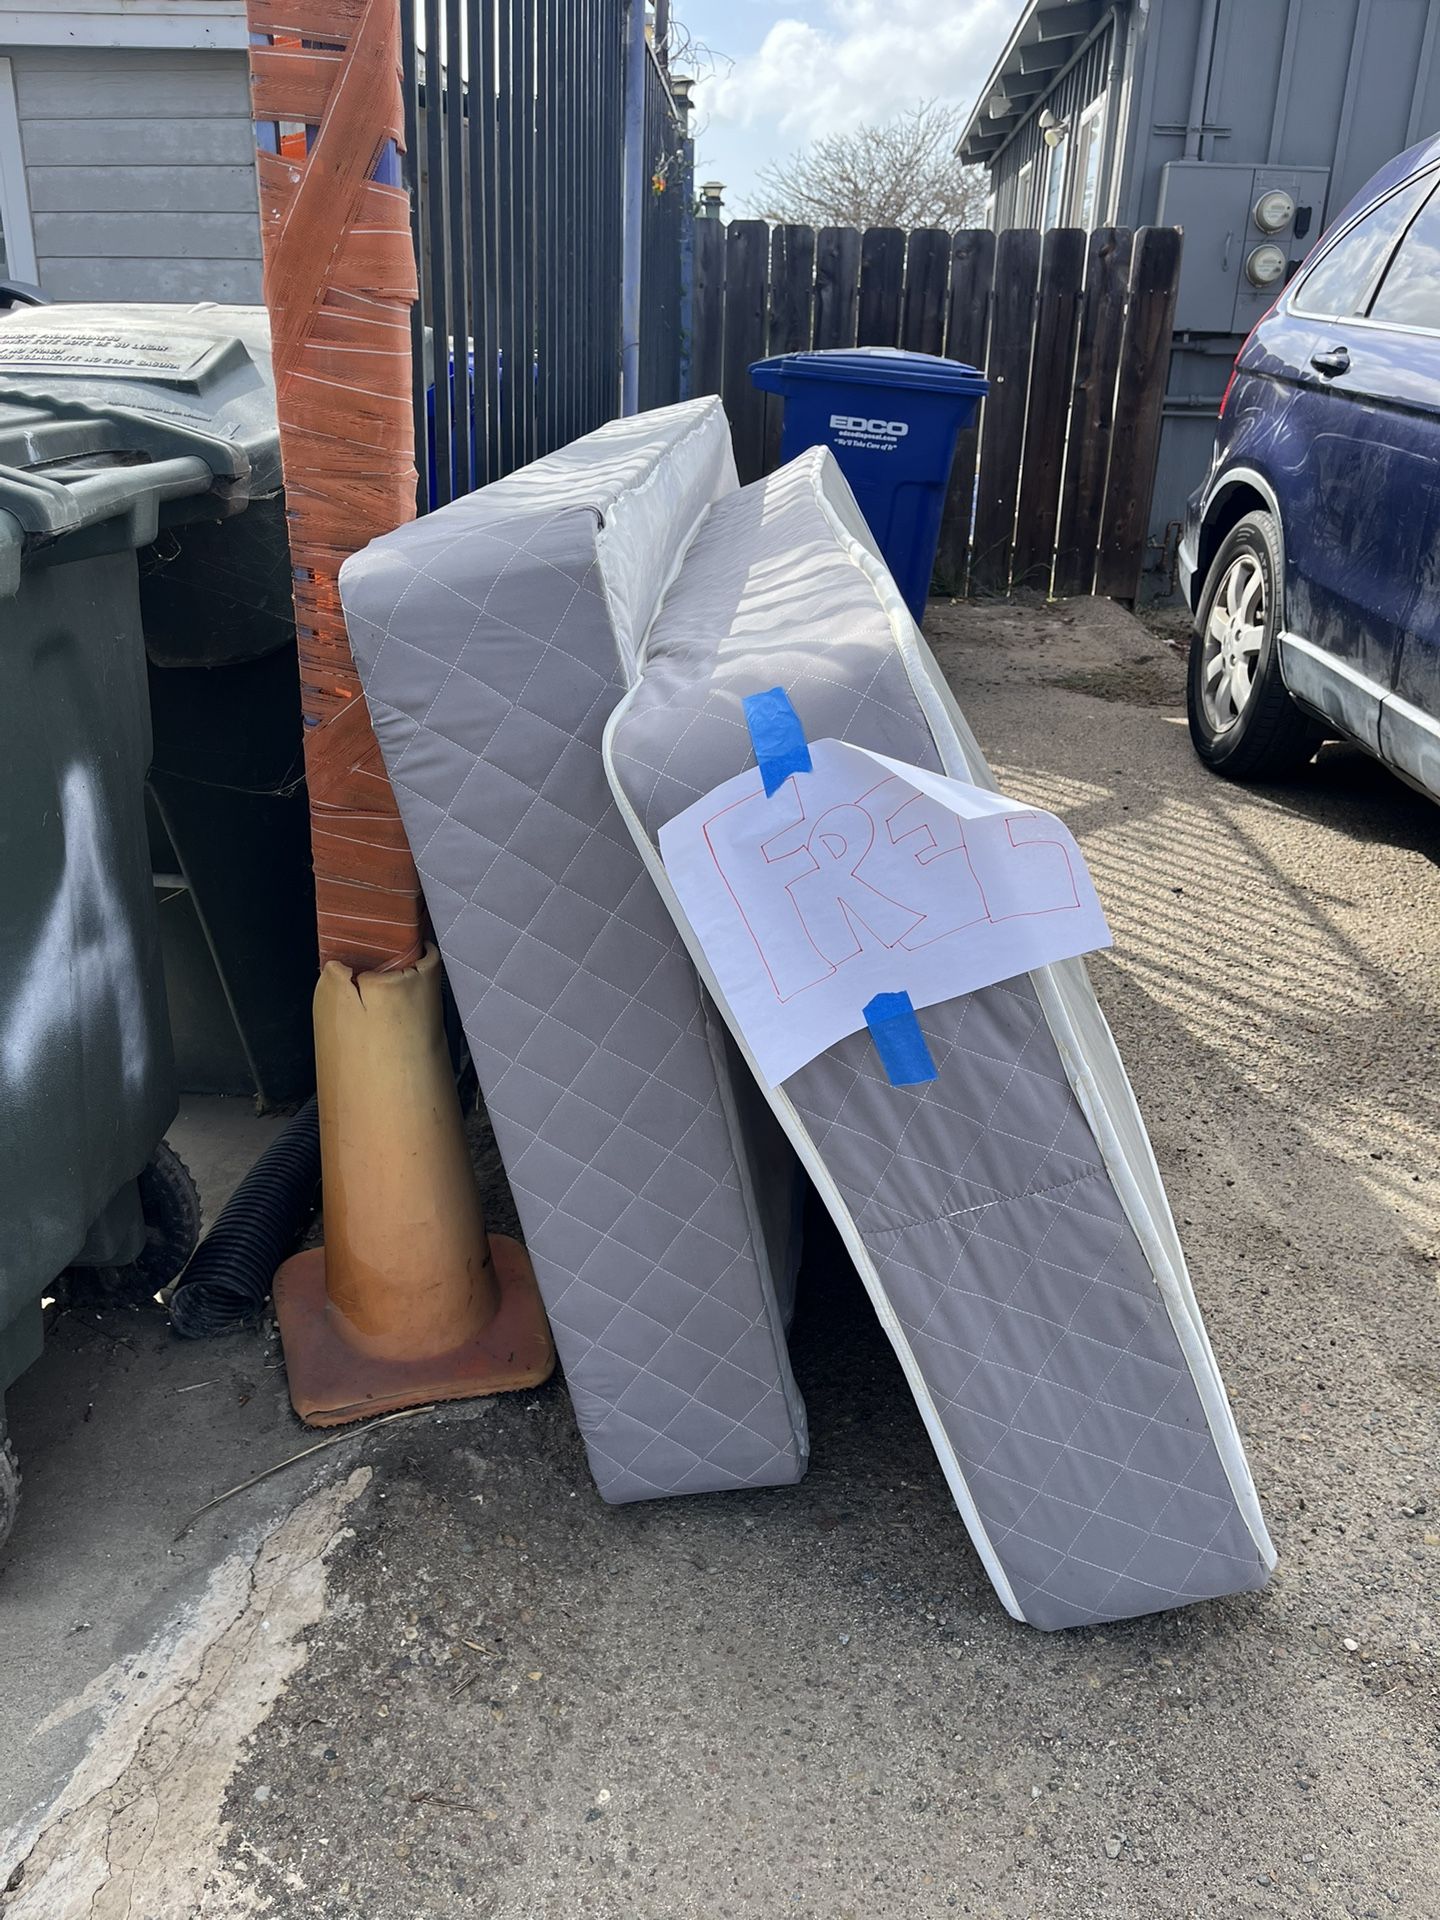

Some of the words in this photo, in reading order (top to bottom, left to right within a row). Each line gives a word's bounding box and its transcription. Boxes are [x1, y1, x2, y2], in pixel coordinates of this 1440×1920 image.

[829, 414, 909, 436] EDCO
[838, 430, 898, 442] edcodisposal.com
[853, 439, 866, 448] Take
[866, 441, 880, 449] Care
